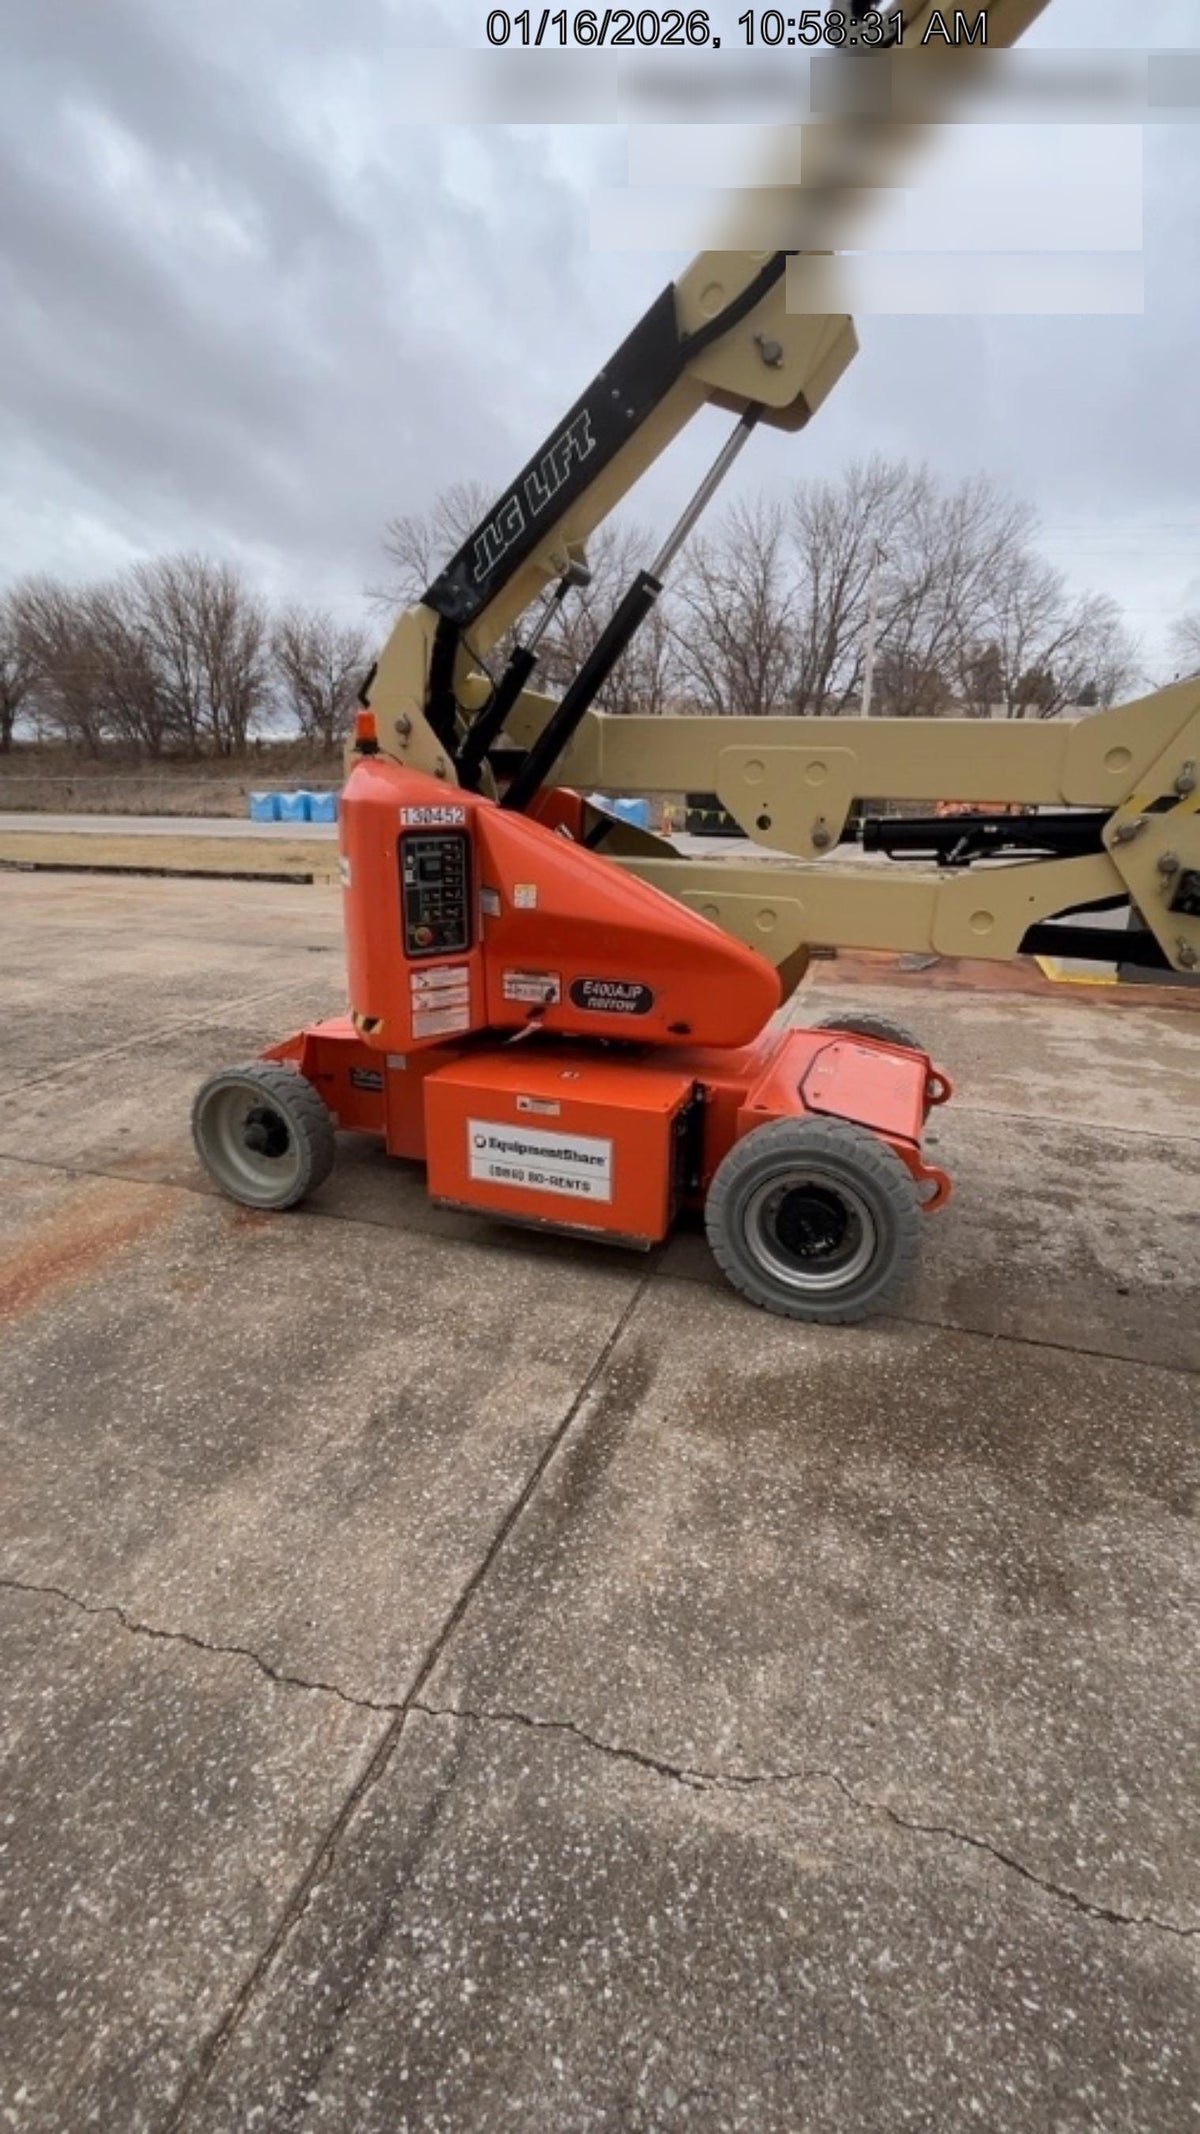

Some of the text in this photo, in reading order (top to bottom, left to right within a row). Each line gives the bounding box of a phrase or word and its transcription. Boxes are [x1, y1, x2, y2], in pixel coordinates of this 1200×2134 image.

[473, 409, 594, 583] JLG LIFT
[402, 807, 464, 824] 130452
[582, 981, 643, 1000] E400AJP
[488, 1137, 606, 1167] EquipmentShare
